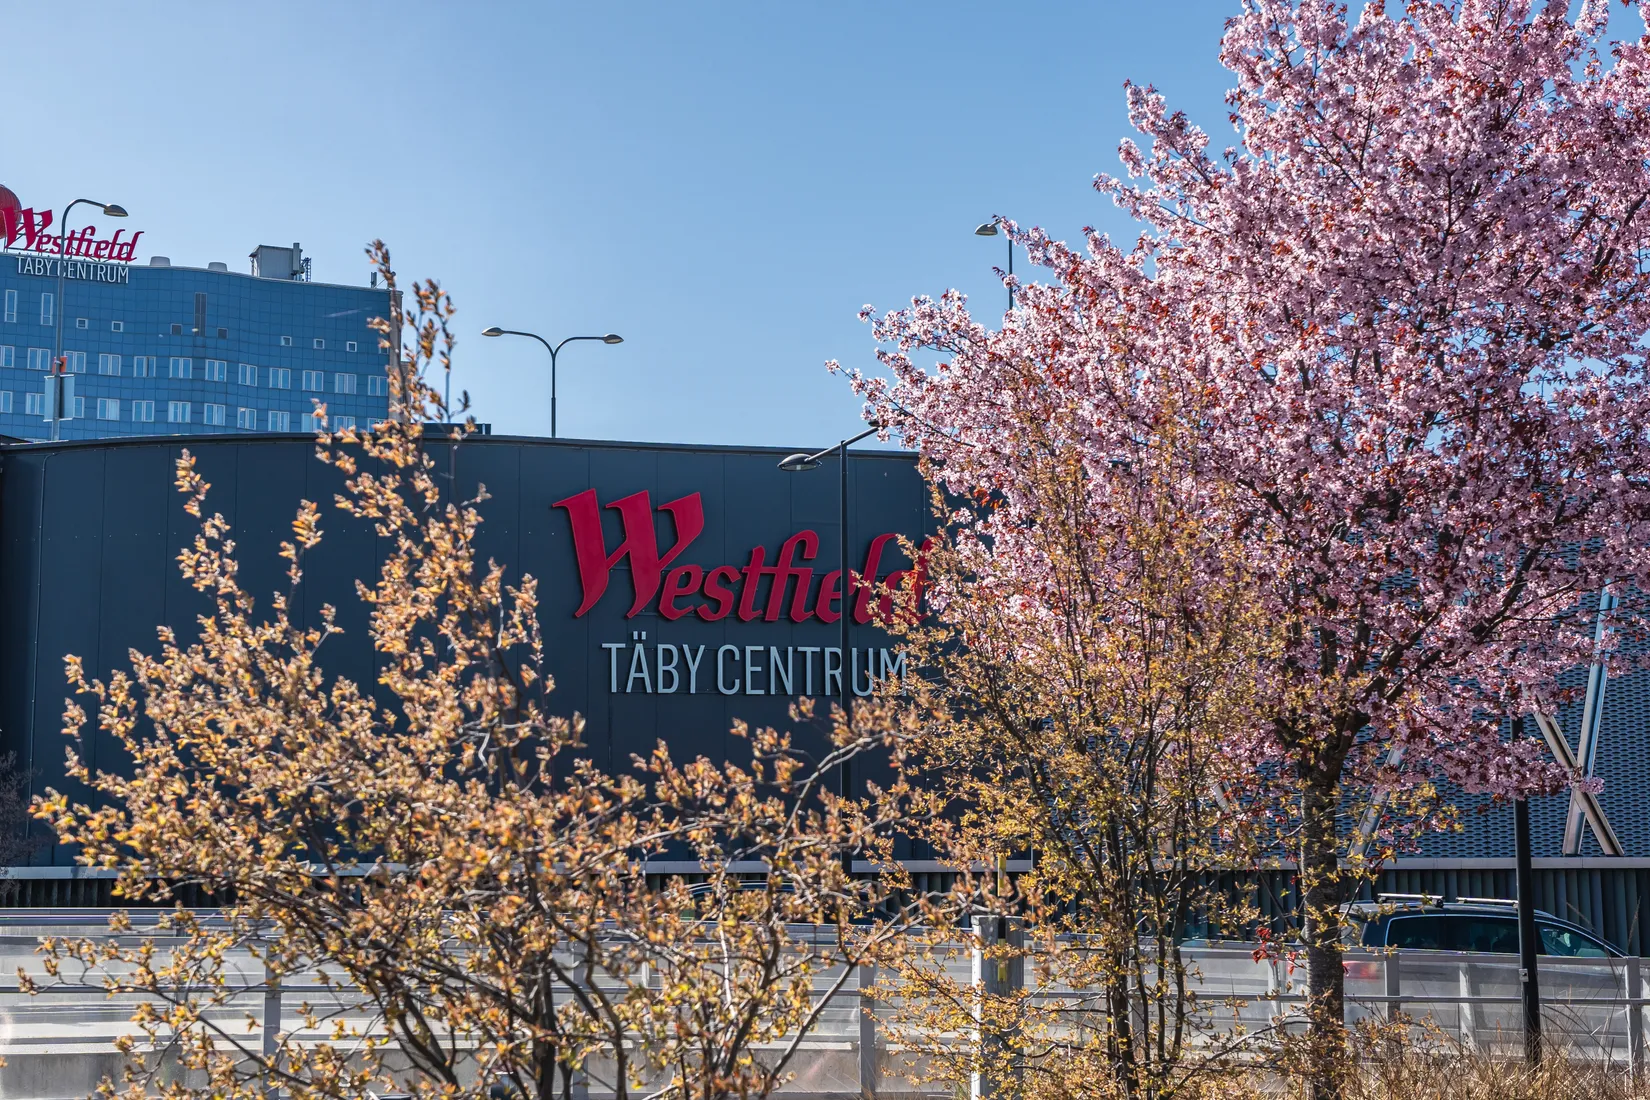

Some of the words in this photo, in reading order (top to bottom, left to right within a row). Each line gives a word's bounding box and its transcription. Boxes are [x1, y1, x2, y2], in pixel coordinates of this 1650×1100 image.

[0, 206, 144, 262] Westfield
[57, 261, 129, 284] CENTRUM
[552, 488, 943, 624] Westfield
[601, 631, 705, 694] TÄBY
[717, 645, 907, 697] CENTRUM
